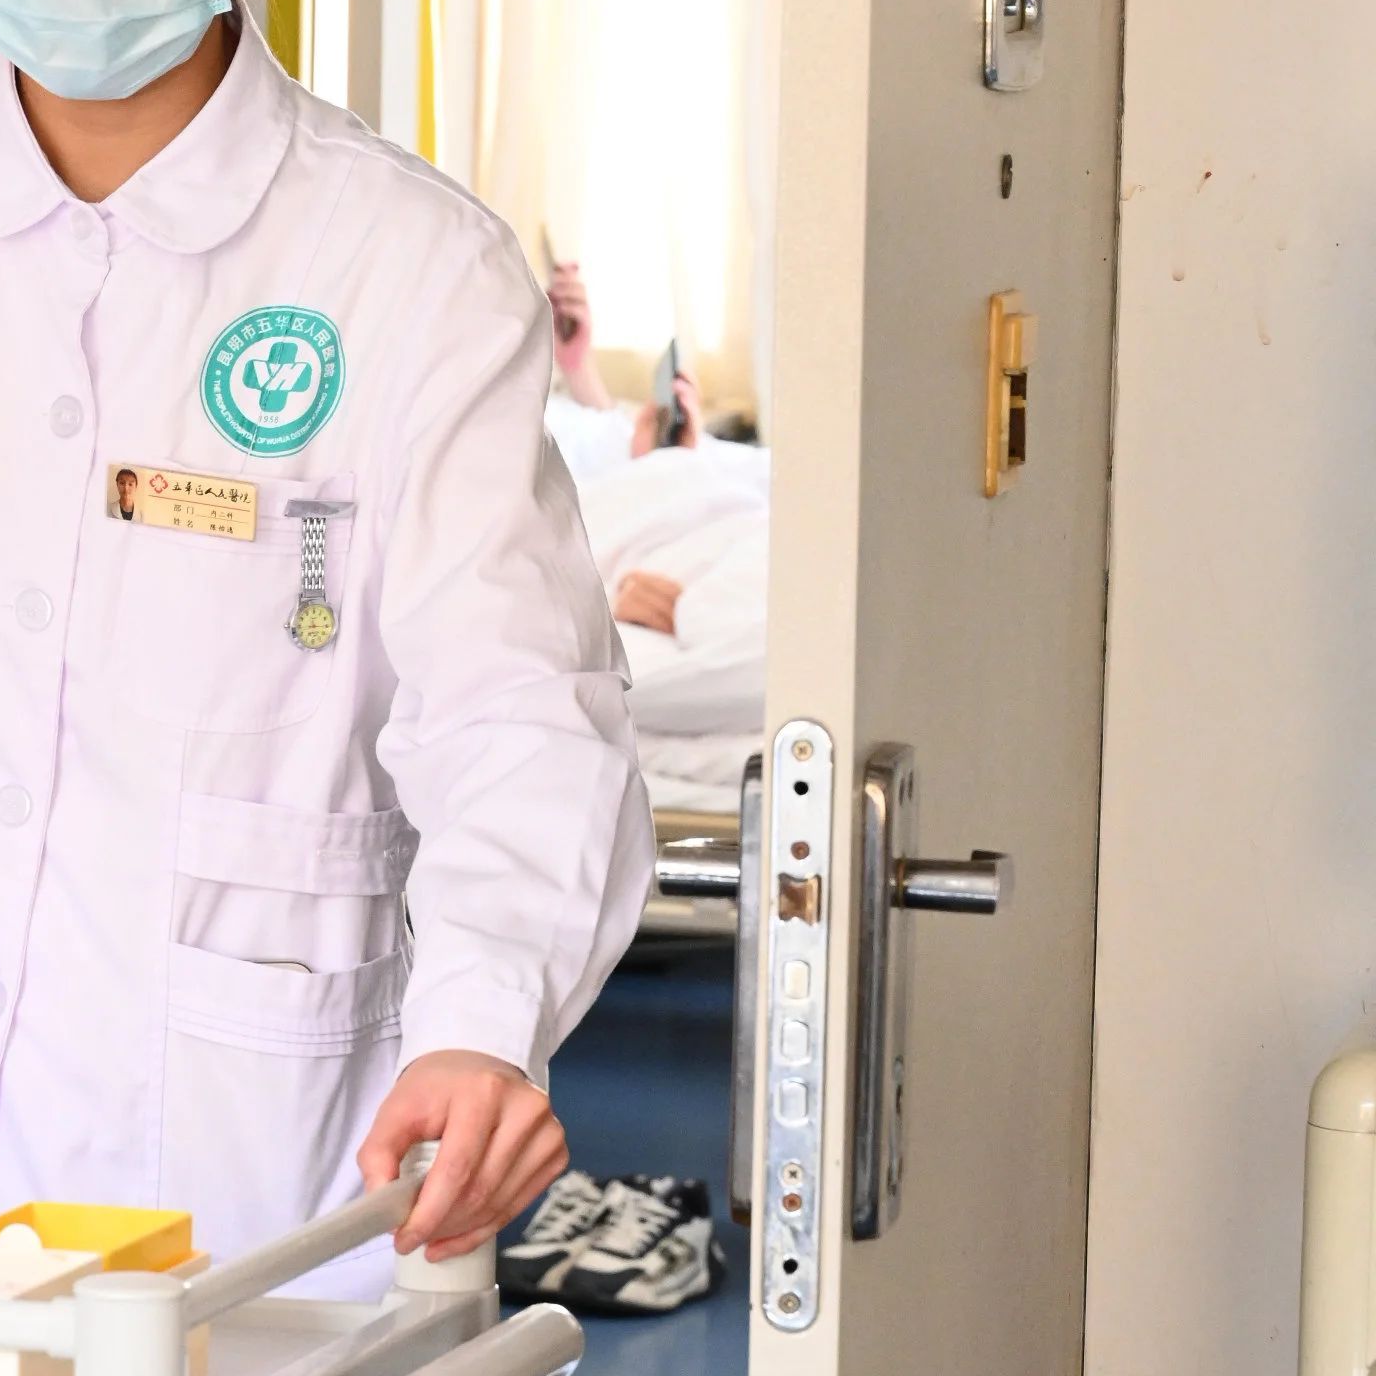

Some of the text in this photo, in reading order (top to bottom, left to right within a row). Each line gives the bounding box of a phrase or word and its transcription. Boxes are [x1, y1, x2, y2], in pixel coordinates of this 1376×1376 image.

[216, 315, 336, 377] 昆明市五华区人民医院
